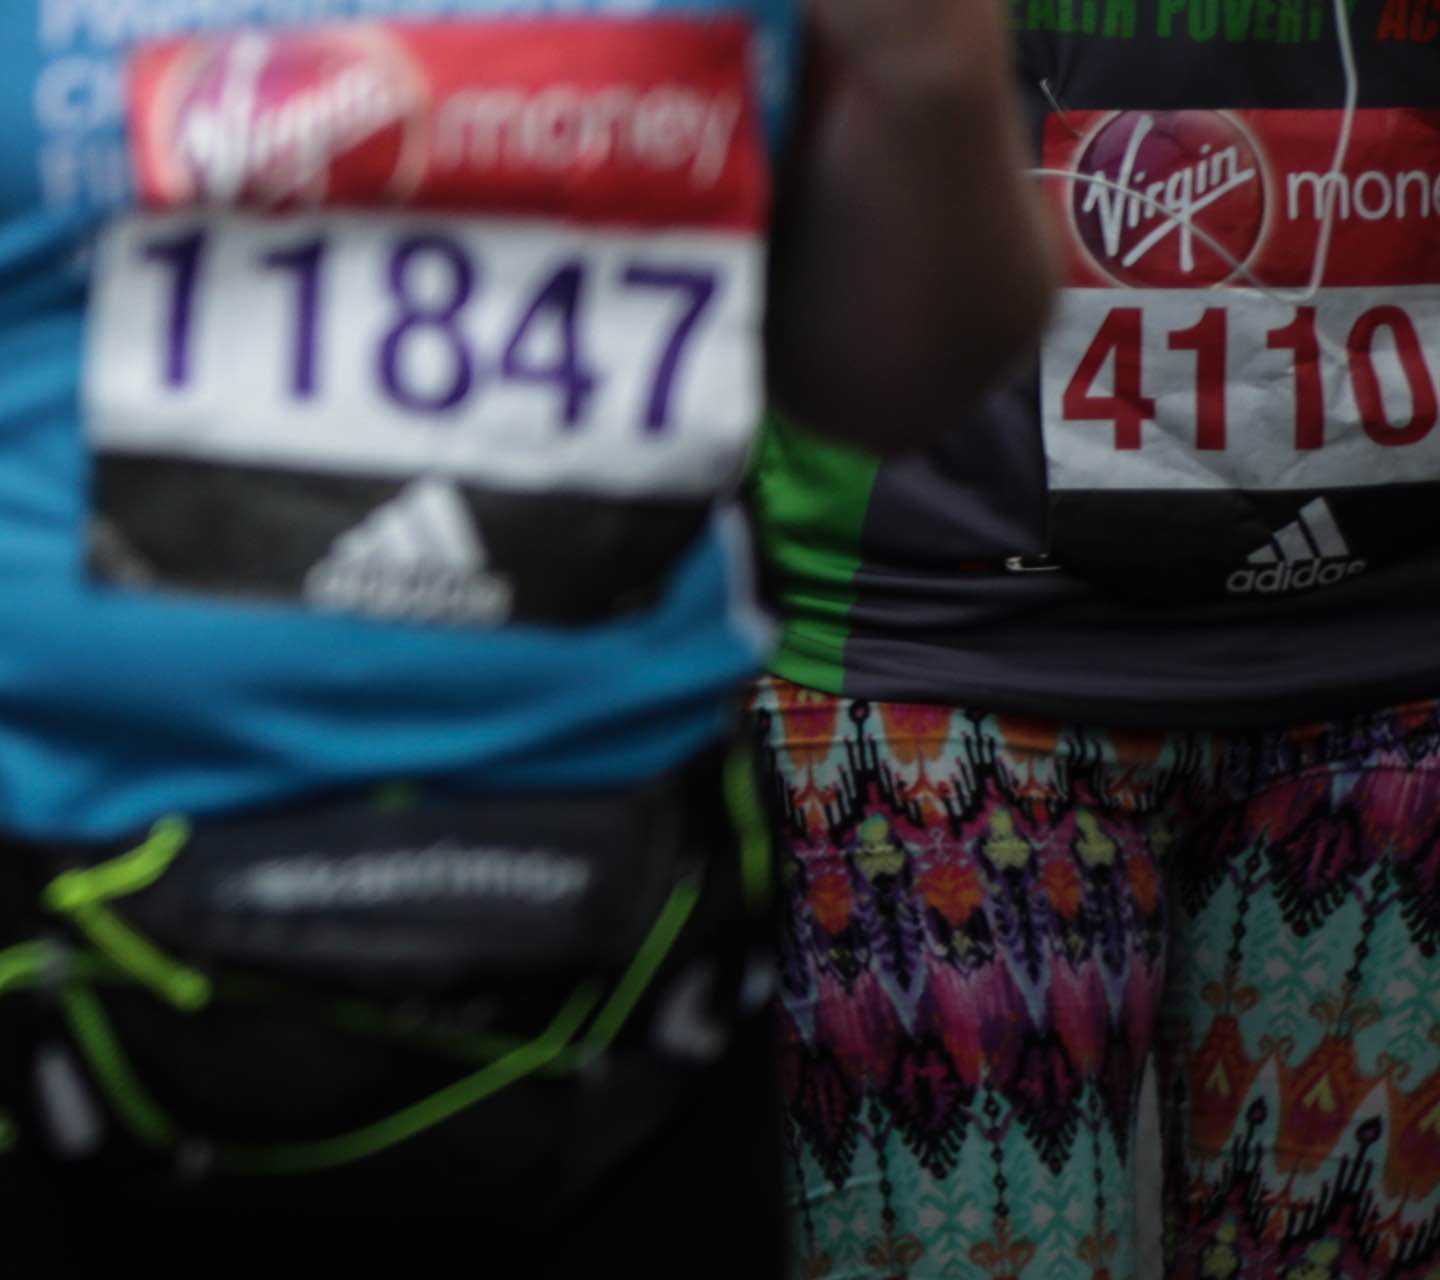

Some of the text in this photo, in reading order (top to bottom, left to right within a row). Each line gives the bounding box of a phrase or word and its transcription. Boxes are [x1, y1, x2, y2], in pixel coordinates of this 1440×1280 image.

[1083, 114, 1440, 272] Virgin mon
[135, 233, 723, 438] 11847
[1061, 304, 1440, 453] 4110
